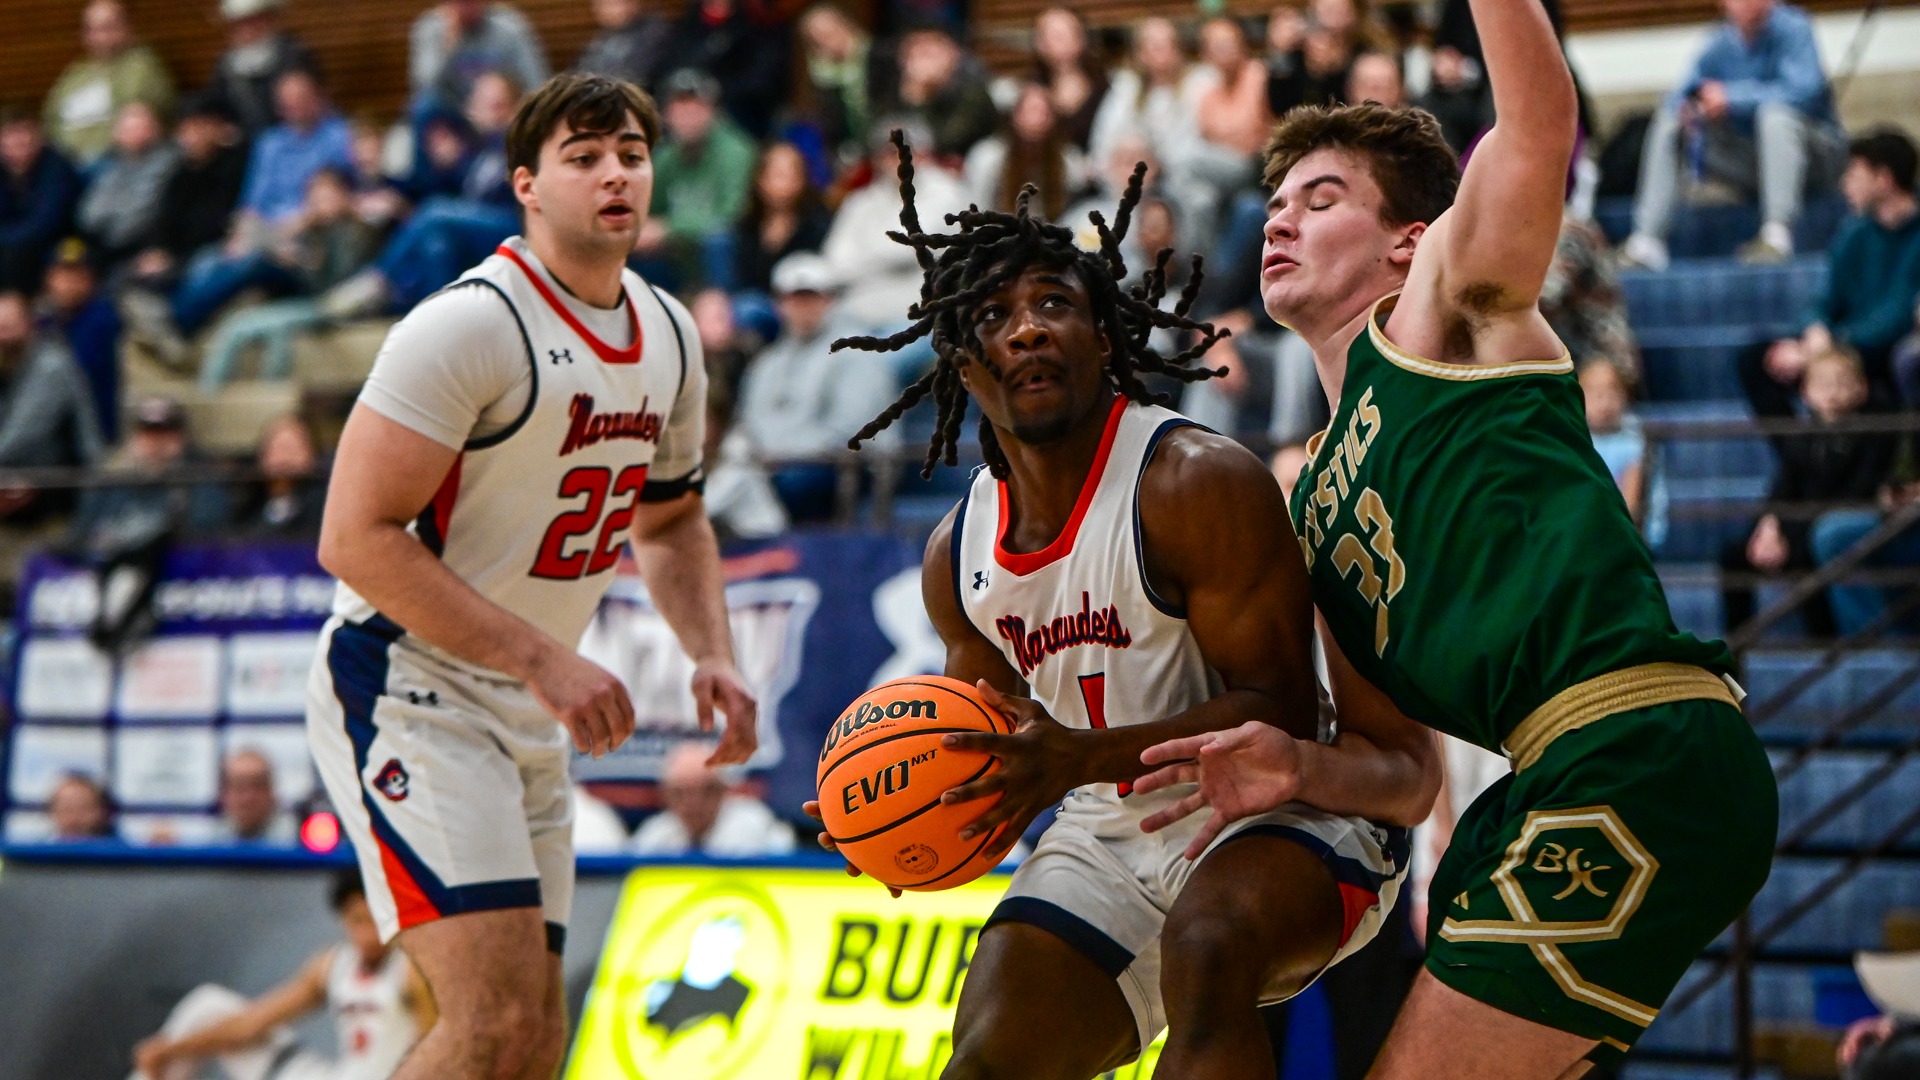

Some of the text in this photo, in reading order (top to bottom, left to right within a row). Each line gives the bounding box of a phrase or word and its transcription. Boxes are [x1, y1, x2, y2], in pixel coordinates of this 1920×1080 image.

[528, 463, 648, 581] 22
[1331, 487, 1406, 660] 33
[821, 700, 938, 762] Wilson
[842, 749, 937, 815] EVO NXT
